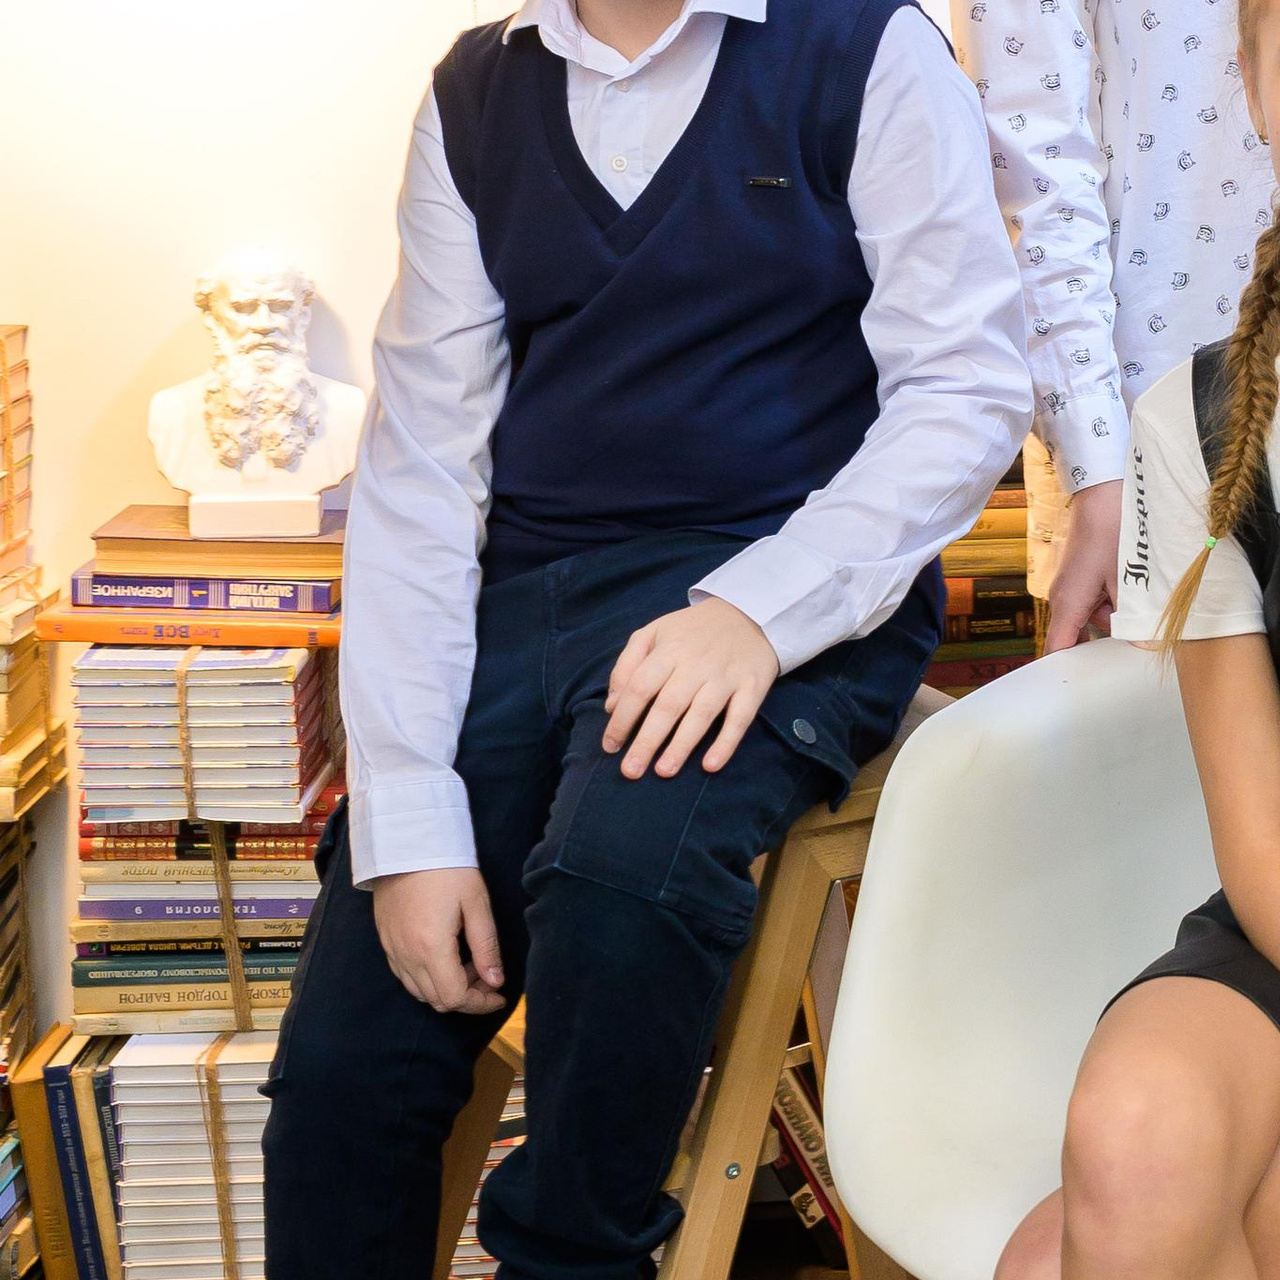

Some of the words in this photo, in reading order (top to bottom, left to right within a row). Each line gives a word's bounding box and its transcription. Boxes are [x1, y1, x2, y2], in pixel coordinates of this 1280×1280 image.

[91, 584, 173, 599] ИЗБРАННОЕ
[164, 905, 257, 915] ТЕХОЛОГИЯ
[118, 993, 171, 1005] БАЙРОН
[176, 989, 228, 1002] ГОРДОН
[244, 987, 291, 1000] ДЖОРД
